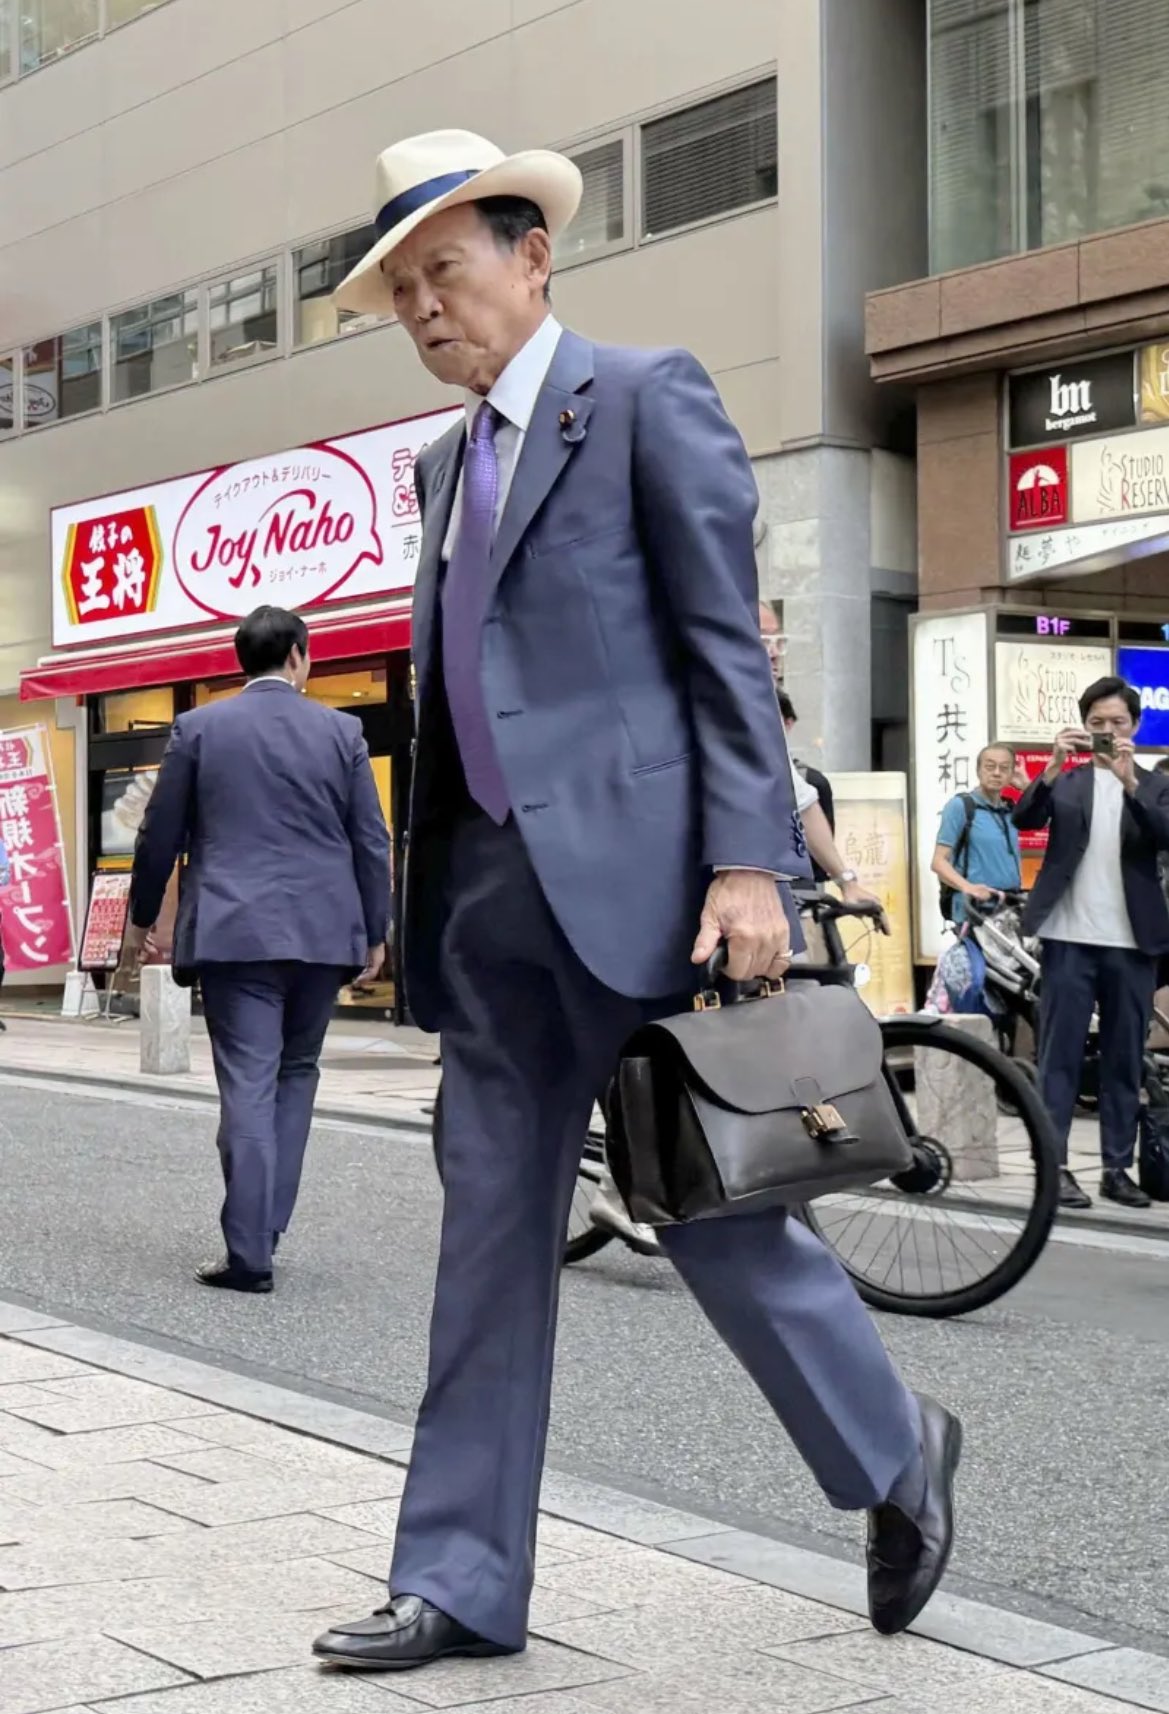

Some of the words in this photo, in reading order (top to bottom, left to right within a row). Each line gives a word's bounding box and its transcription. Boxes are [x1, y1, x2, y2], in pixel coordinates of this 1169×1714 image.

[1045, 412, 1097, 431] bergamot
[392, 446, 419, 482] テ
[213, 465, 333, 509] テイクアウト&デリバリー
[1017, 489, 1061, 519] ALBA
[88, 522, 133, 553] 餃子の
[190, 524, 259, 588] Joy
[260, 492, 354, 558] Naho
[402, 533, 419, 560] 赤
[79, 547, 146, 613] 王将
[269, 561, 328, 583] ジョイ・ナーホ
[1036, 615, 1071, 636] B1F
[933, 637, 971, 693] TS
[1130, 685, 1169, 711] AG
[936, 703, 970, 795] 共和
